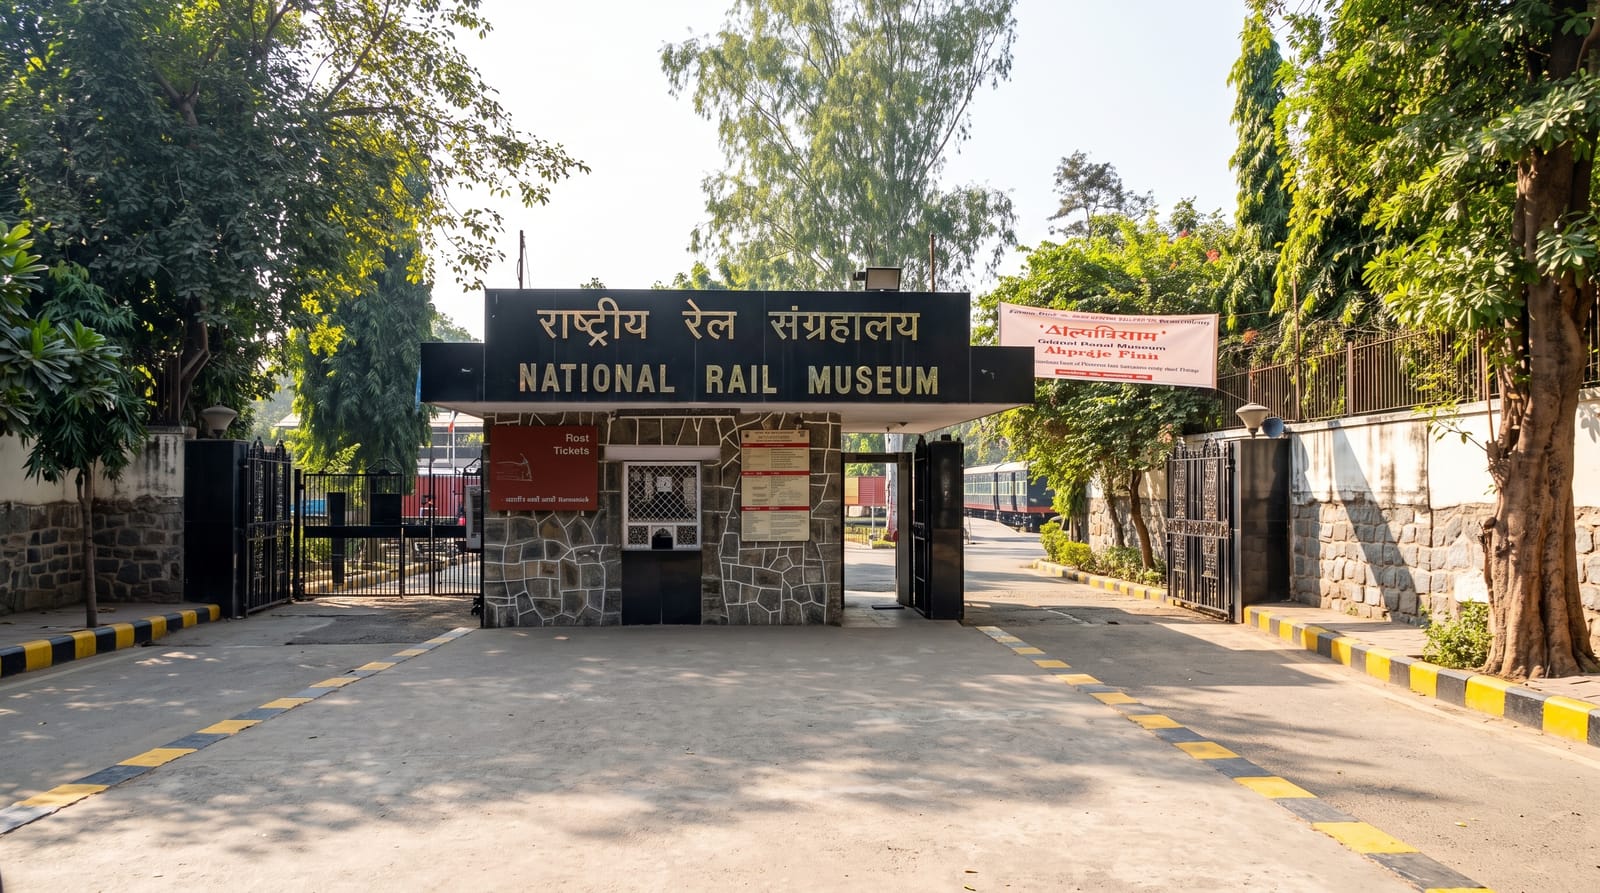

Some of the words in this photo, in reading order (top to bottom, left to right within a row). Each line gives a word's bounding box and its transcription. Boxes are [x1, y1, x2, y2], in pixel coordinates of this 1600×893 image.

[537, 297, 649, 347] राष्ट्रीय
[681, 299, 737, 340] रेल
[768, 305, 920, 343] संग्रहालय
[519, 363, 675, 393] NATIONAL
[706, 364, 777, 394] RAIL
[808, 365, 939, 395] MUSEUM
[565, 433, 590, 442] Rost
[553, 446, 590, 455] Tickets
